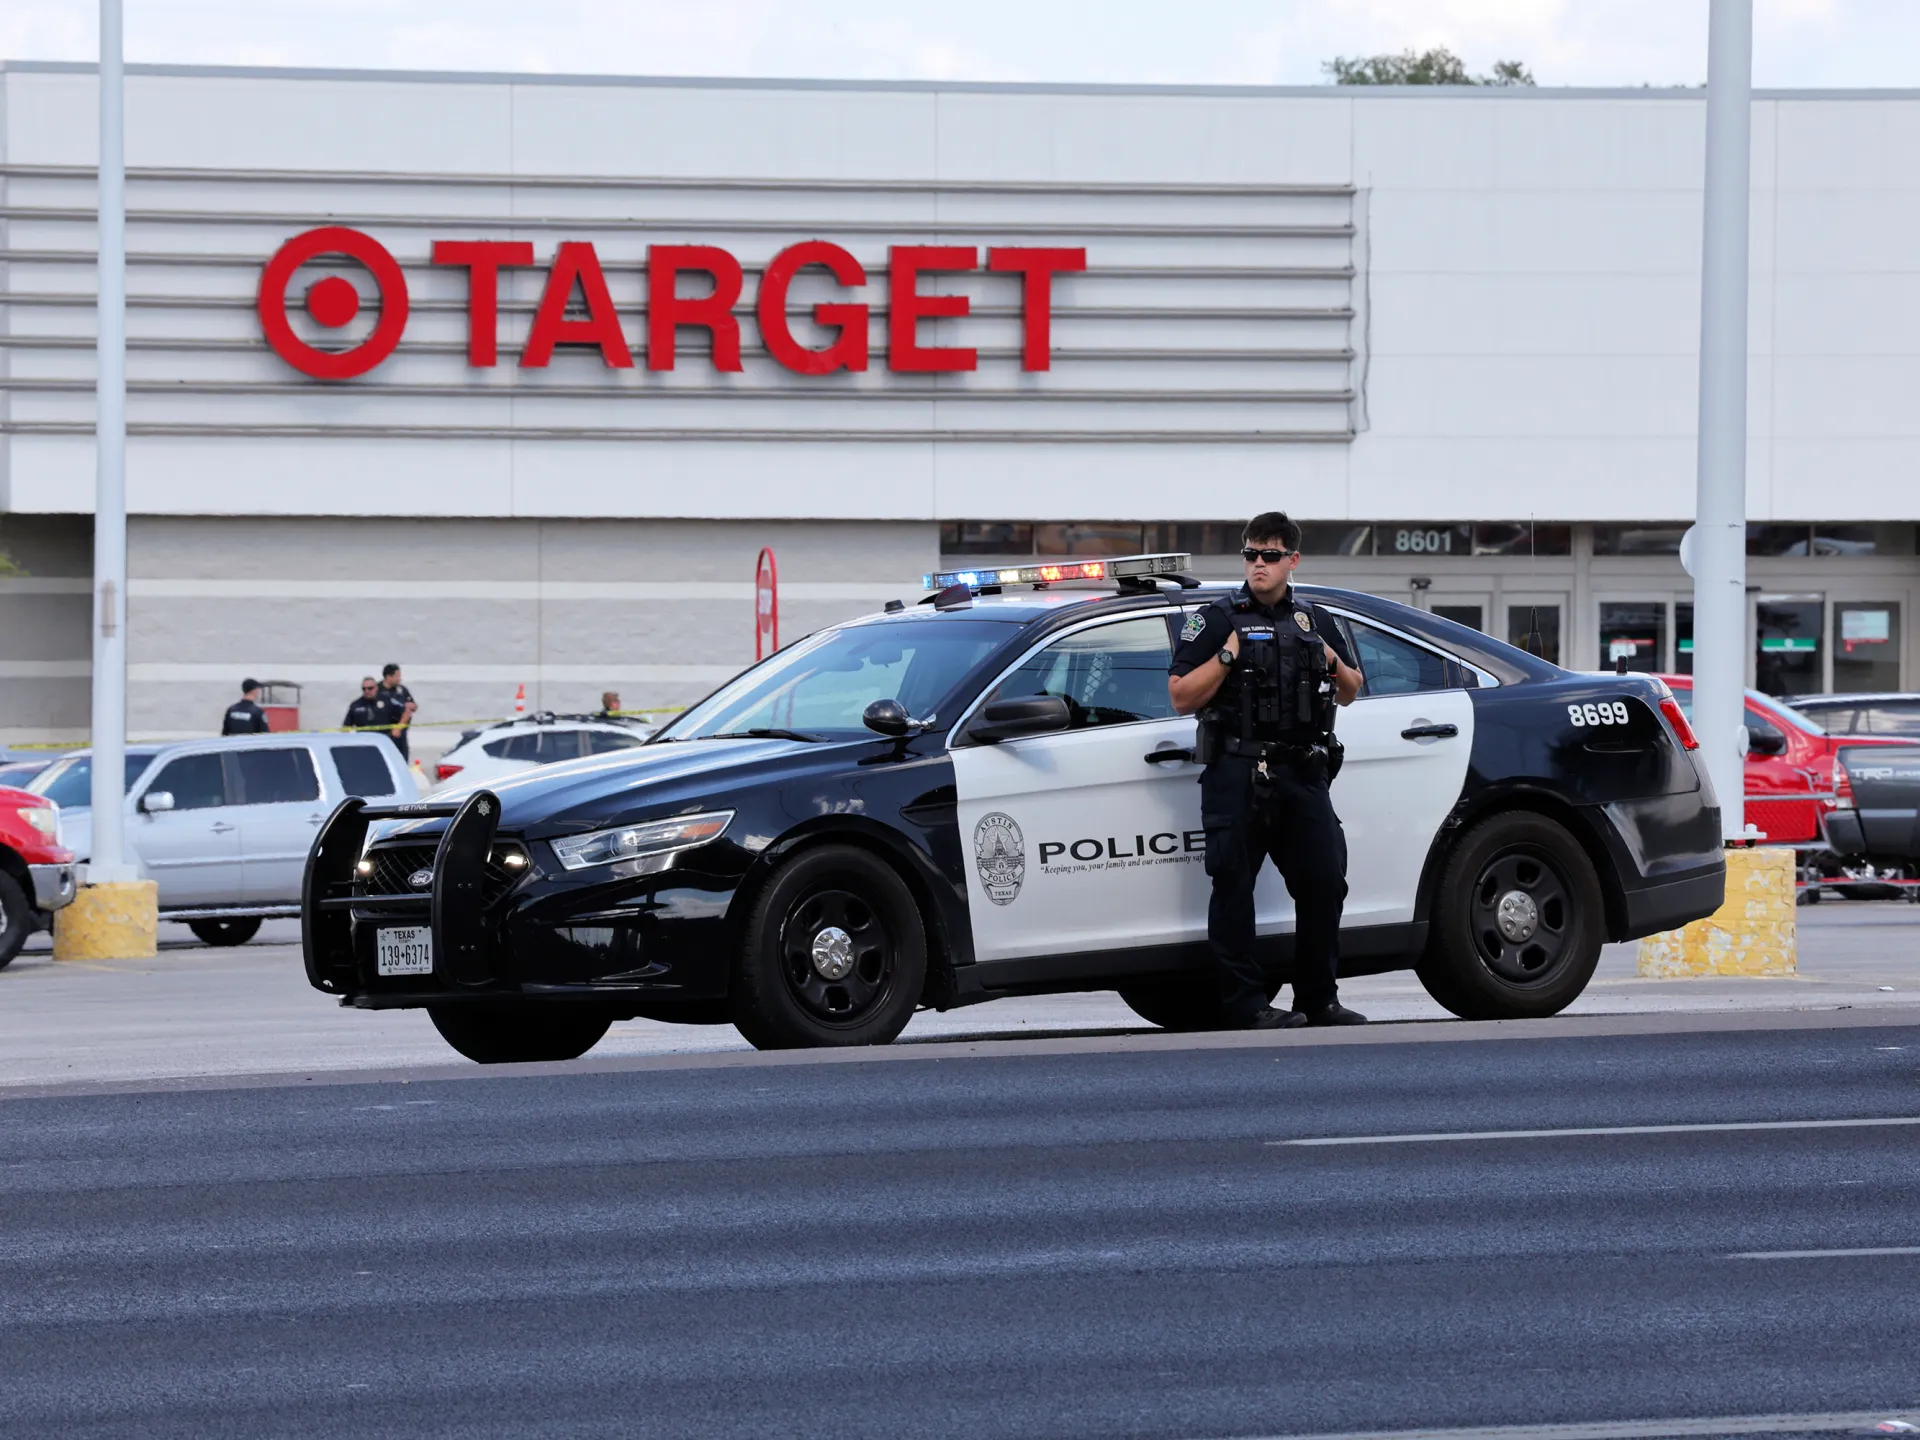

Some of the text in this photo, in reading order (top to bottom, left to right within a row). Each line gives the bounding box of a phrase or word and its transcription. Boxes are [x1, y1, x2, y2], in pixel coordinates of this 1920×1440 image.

[431, 240, 1086, 375] TARGET
[1395, 530, 1451, 552] 8601
[1567, 701, 1629, 727] 8699
[1850, 767, 1894, 780] TRD
[398, 804, 428, 812] SETINA
[980, 817, 1014, 833] AUSTIN
[1038, 829, 1206, 865] POLICE
[1088, 862, 1105, 872] your
[1104, 860, 1127, 870] family
[1127, 858, 1141, 867] and
[1154, 854, 1191, 864] community
[987, 871, 1017, 883] POLICE
[393, 930, 416, 940] TEXAS
